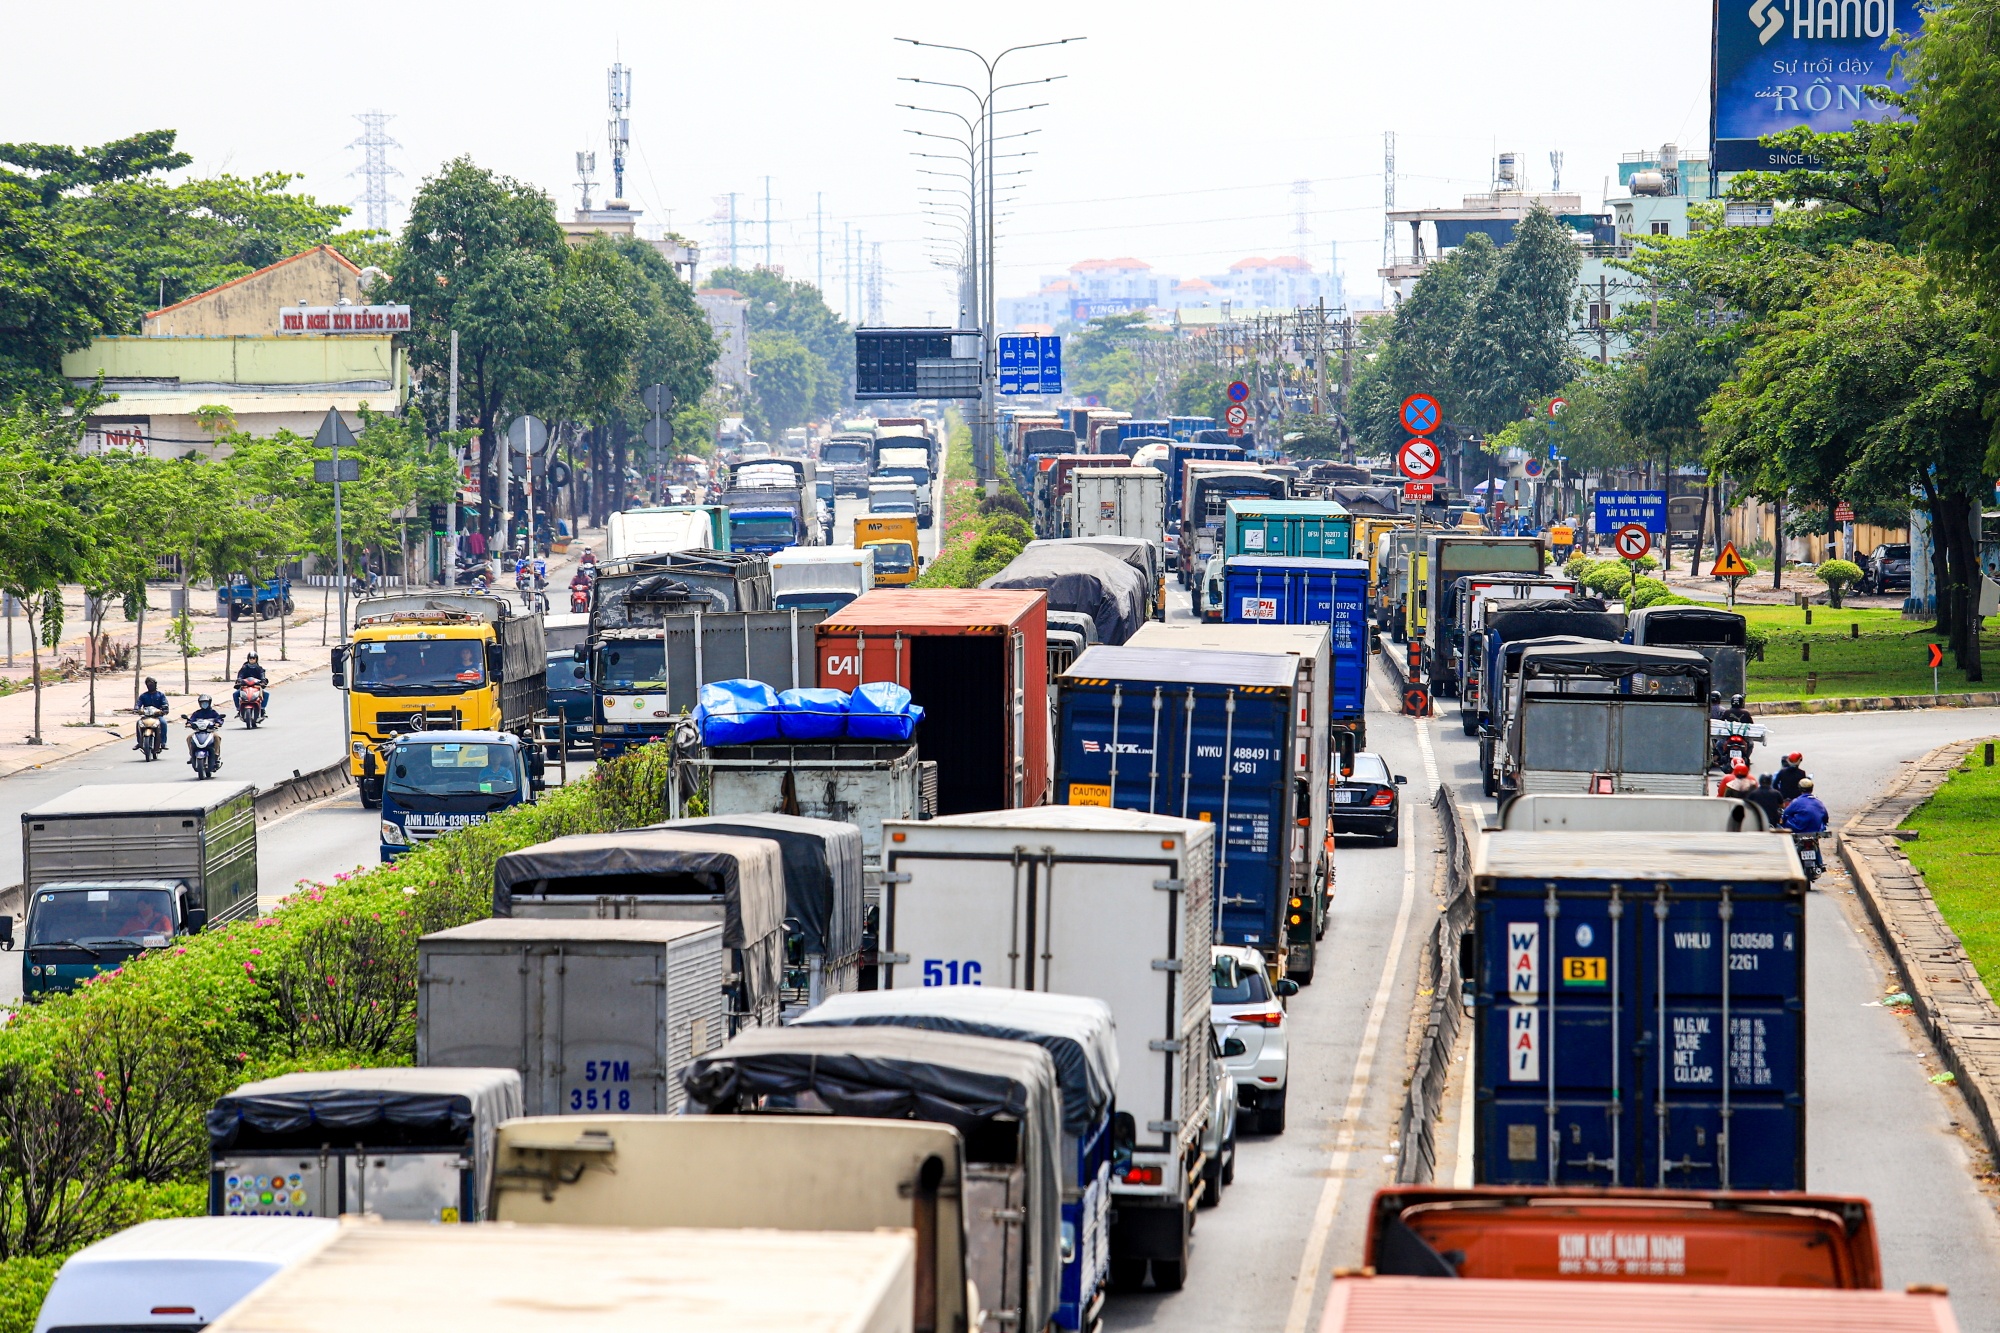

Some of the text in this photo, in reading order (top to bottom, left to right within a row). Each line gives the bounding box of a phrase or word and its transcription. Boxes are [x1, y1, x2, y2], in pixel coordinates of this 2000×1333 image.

[1773, 60, 1797, 76] Sự
[1839, 58, 1873, 75] dậy
[1769, 154, 1803, 165] SINCE
[283, 312, 304, 329] NHÀ
[333, 313, 352, 329] KIM
[106, 425, 145, 445] NHÀ
[1620, 508, 1628, 516] RA
[1630, 508, 1640, 516] TAI
[1259, 601, 1275, 609] PIL
[1336, 602, 1357, 610] 017242
[1104, 743, 1139, 753] NYK
[1197, 745, 1222, 758] NYKU
[1233, 748, 1269, 761] 488491
[1232, 762, 1257, 774] 45G1
[1072, 786, 1108, 797] CAUTION
[1674, 932, 1794, 950] WHLU 030508 4
[1511, 933, 1535, 991] WAN
[1570, 960, 1599, 978] B1
[1729, 954, 1758, 970] 22G1
[923, 960, 982, 987] 51C
[1673, 1017, 1711, 1034] M.G.W.
[1514, 1012, 1533, 1070] HAI
[1675, 1034, 1700, 1050] TARE
[1674, 1050, 1695, 1066] NET
[585, 1060, 630, 1082] 57M
[570, 1088, 630, 1111] 3518
